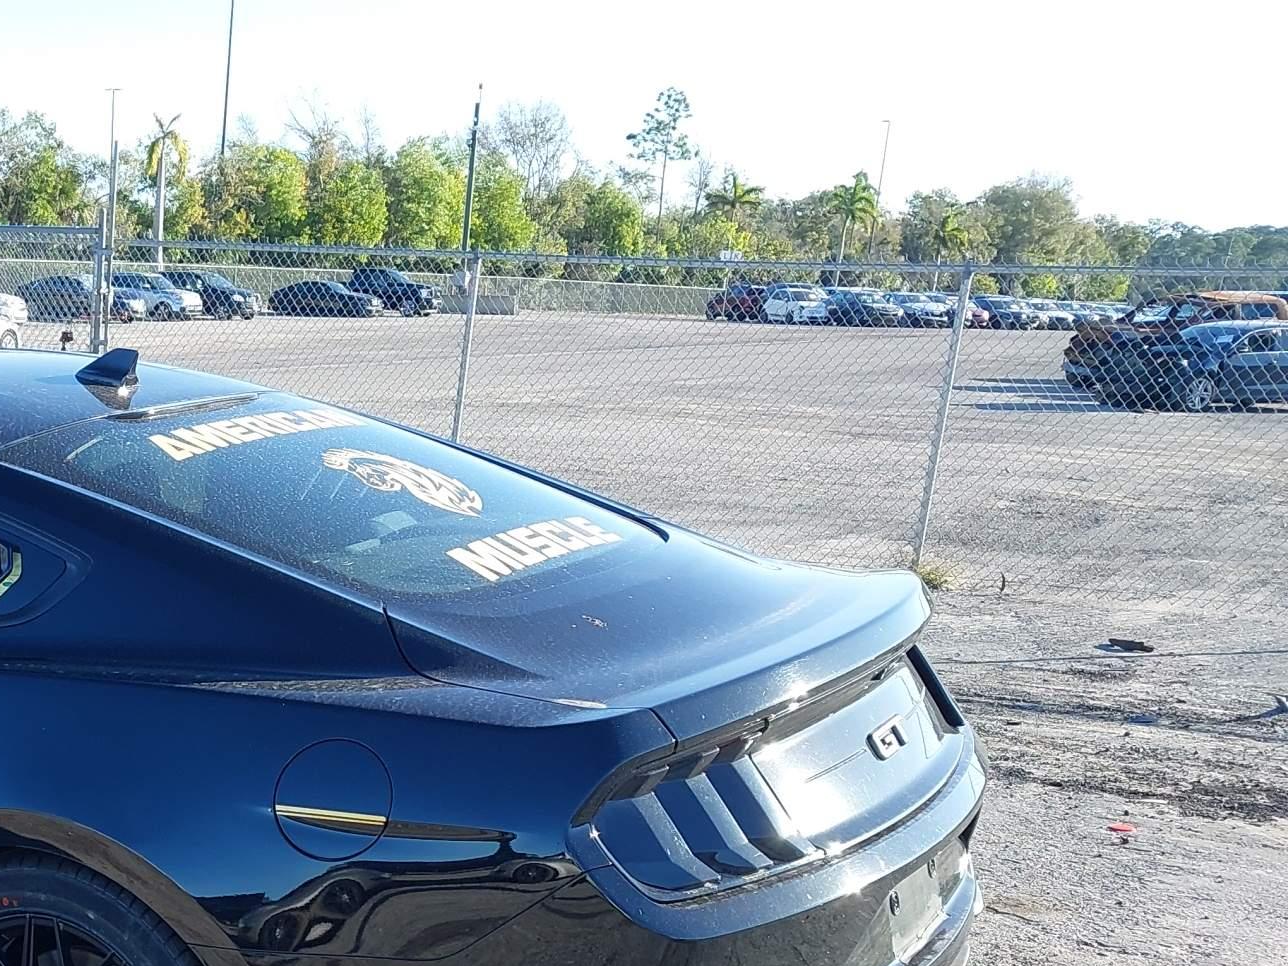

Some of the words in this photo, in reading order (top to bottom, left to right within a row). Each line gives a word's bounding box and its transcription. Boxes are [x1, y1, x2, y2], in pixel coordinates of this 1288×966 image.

[148, 408, 368, 462] AMERICAN
[445, 515, 623, 583] MUSCLE
[865, 713, 907, 762] GT
